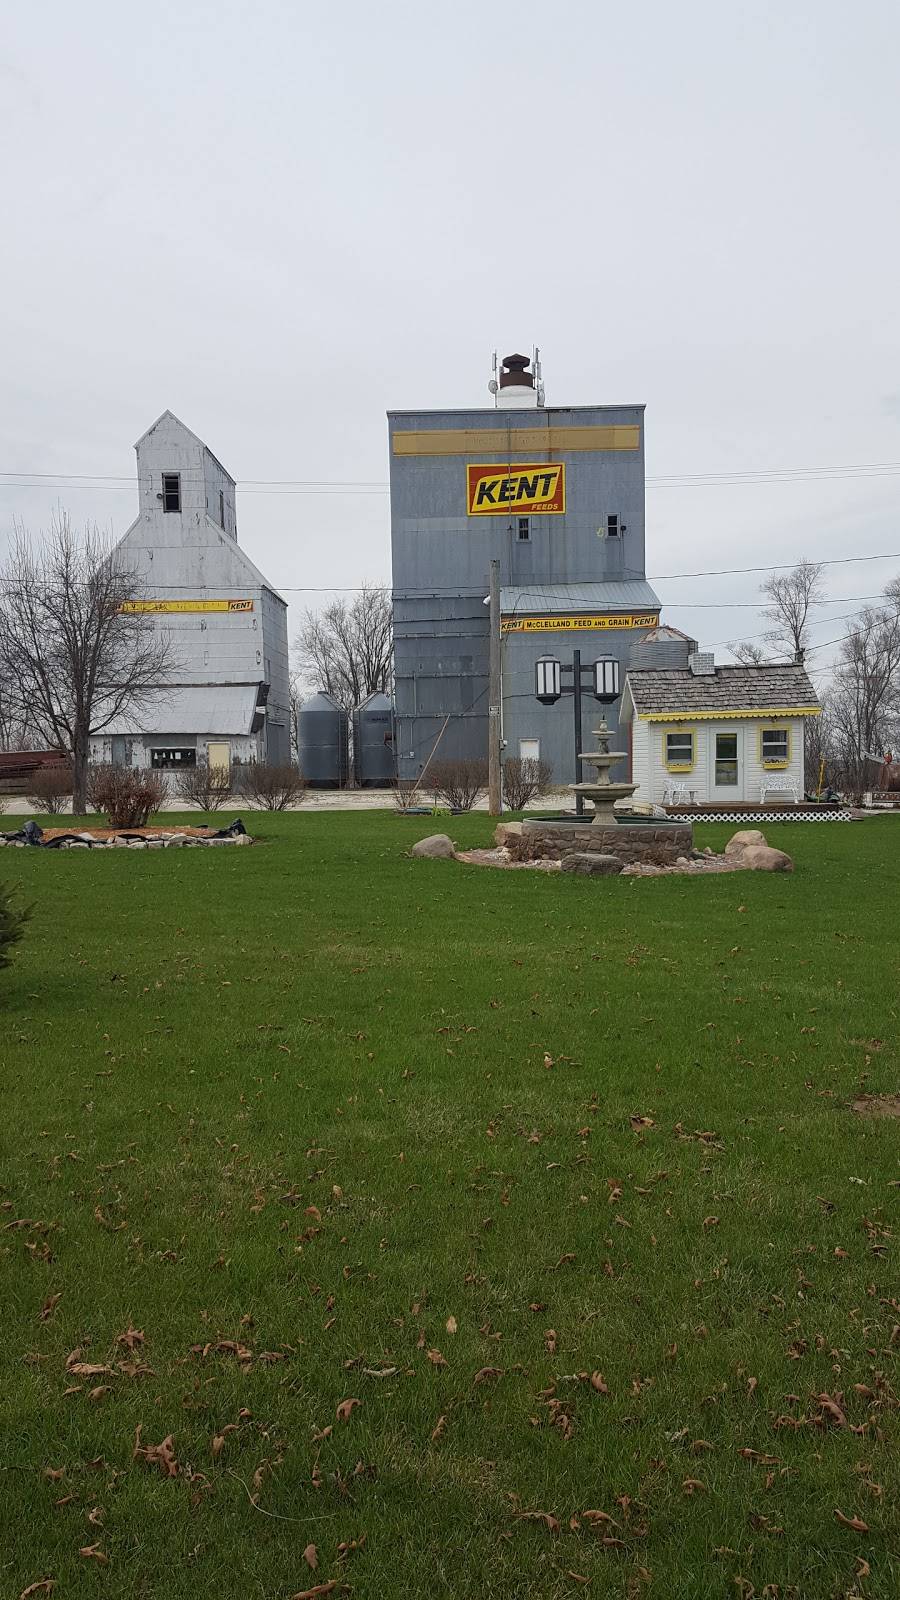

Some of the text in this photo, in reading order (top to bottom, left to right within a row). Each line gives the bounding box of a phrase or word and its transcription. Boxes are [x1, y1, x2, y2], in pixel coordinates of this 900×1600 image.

[477, 473, 557, 505] KENT
[531, 503, 558, 511] FEEDS
[231, 602, 250, 610] KENT
[501, 621, 522, 629] KENT
[526, 620, 571, 628] McCLELLAND
[574, 619, 592, 627] FEED
[634, 617, 655, 626] KENT
